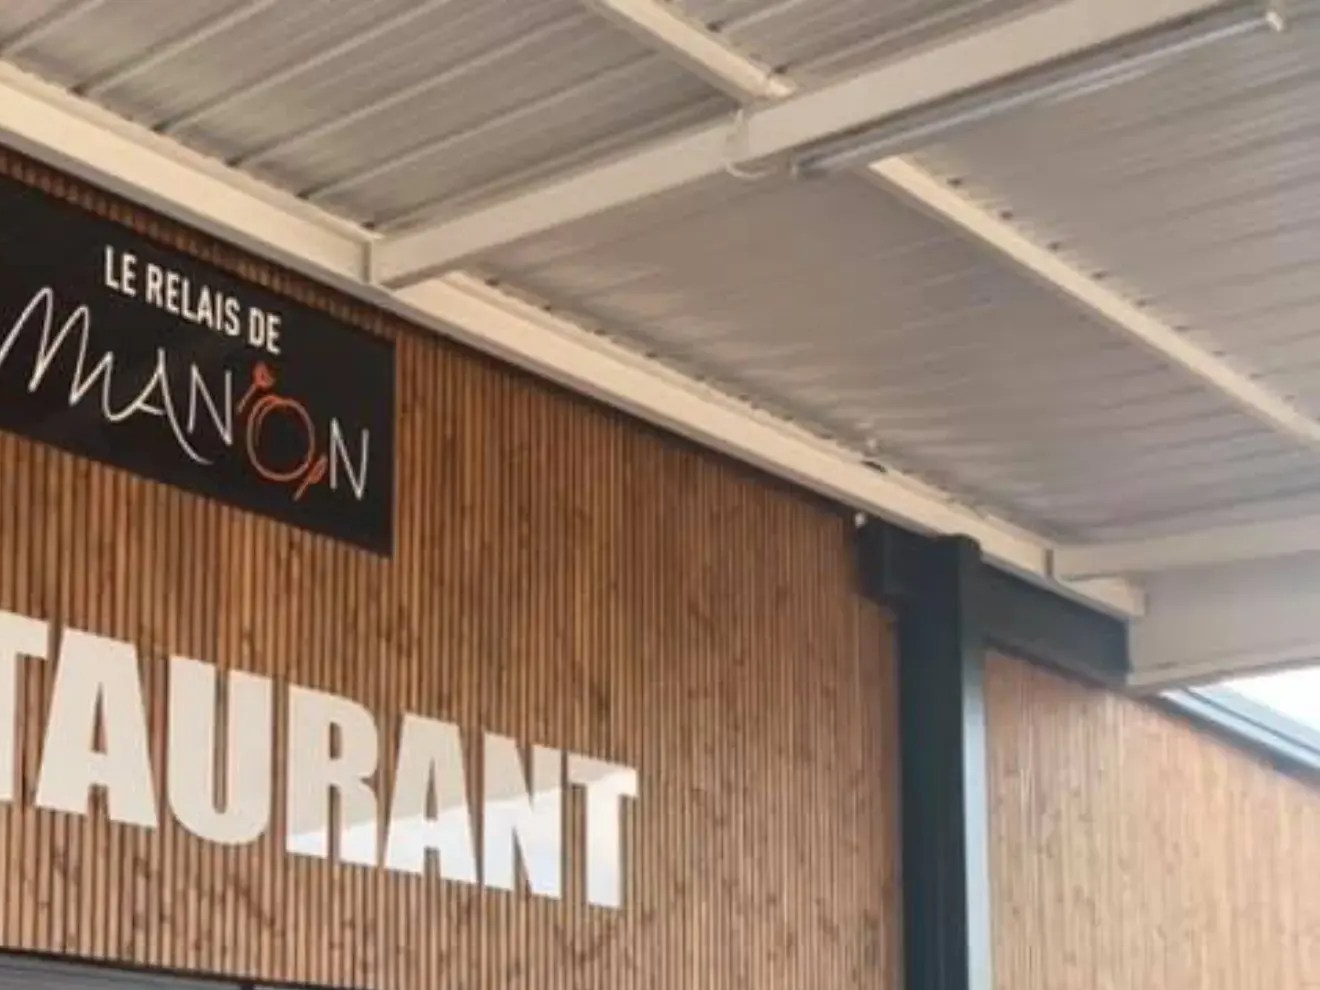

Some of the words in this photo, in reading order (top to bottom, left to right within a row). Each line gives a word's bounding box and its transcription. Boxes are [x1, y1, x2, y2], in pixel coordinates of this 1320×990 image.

[105, 245, 137, 297] LE
[145, 263, 241, 337] RELAIS
[248, 306, 282, 355] DE
